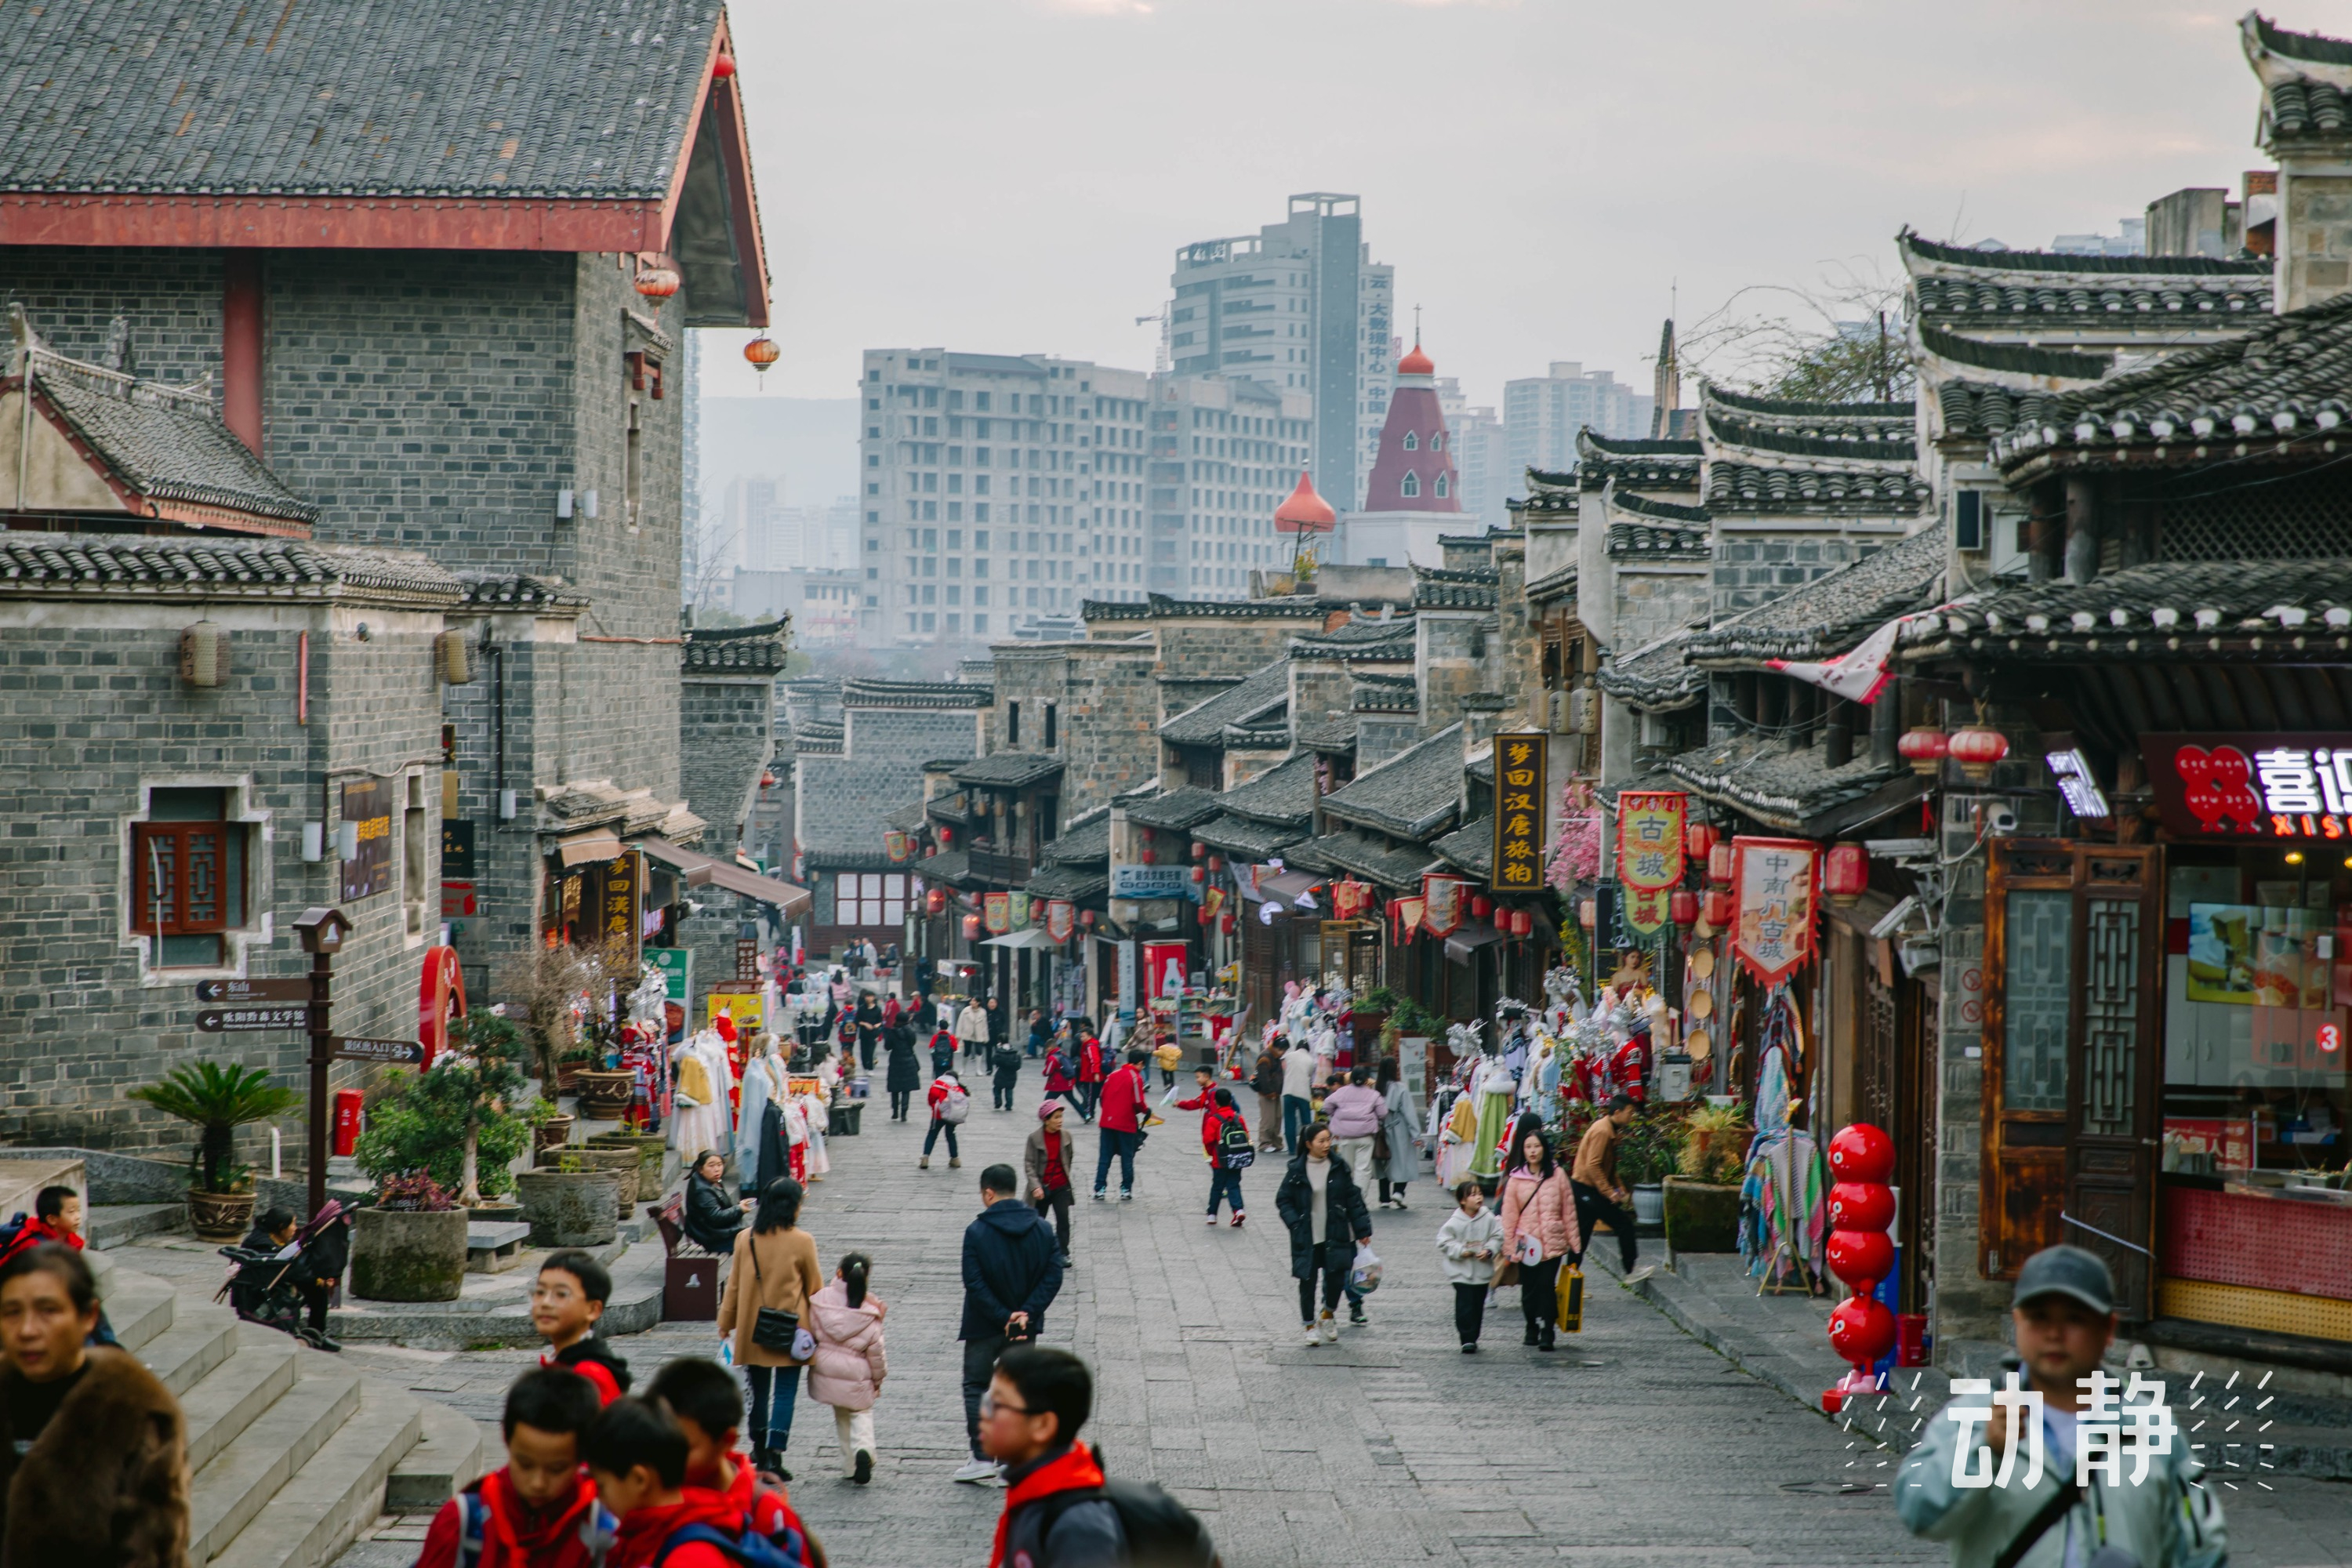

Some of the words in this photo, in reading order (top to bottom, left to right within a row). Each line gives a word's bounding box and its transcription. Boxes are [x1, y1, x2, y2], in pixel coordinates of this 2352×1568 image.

[1503, 742, 1536, 884] 梦回汉唐旅拍
[1629, 797, 1678, 812] 中南门
[2271, 814, 2352, 839] XIS
[1636, 815, 1668, 880] 古城
[1759, 855, 1790, 960] 中南门古城
